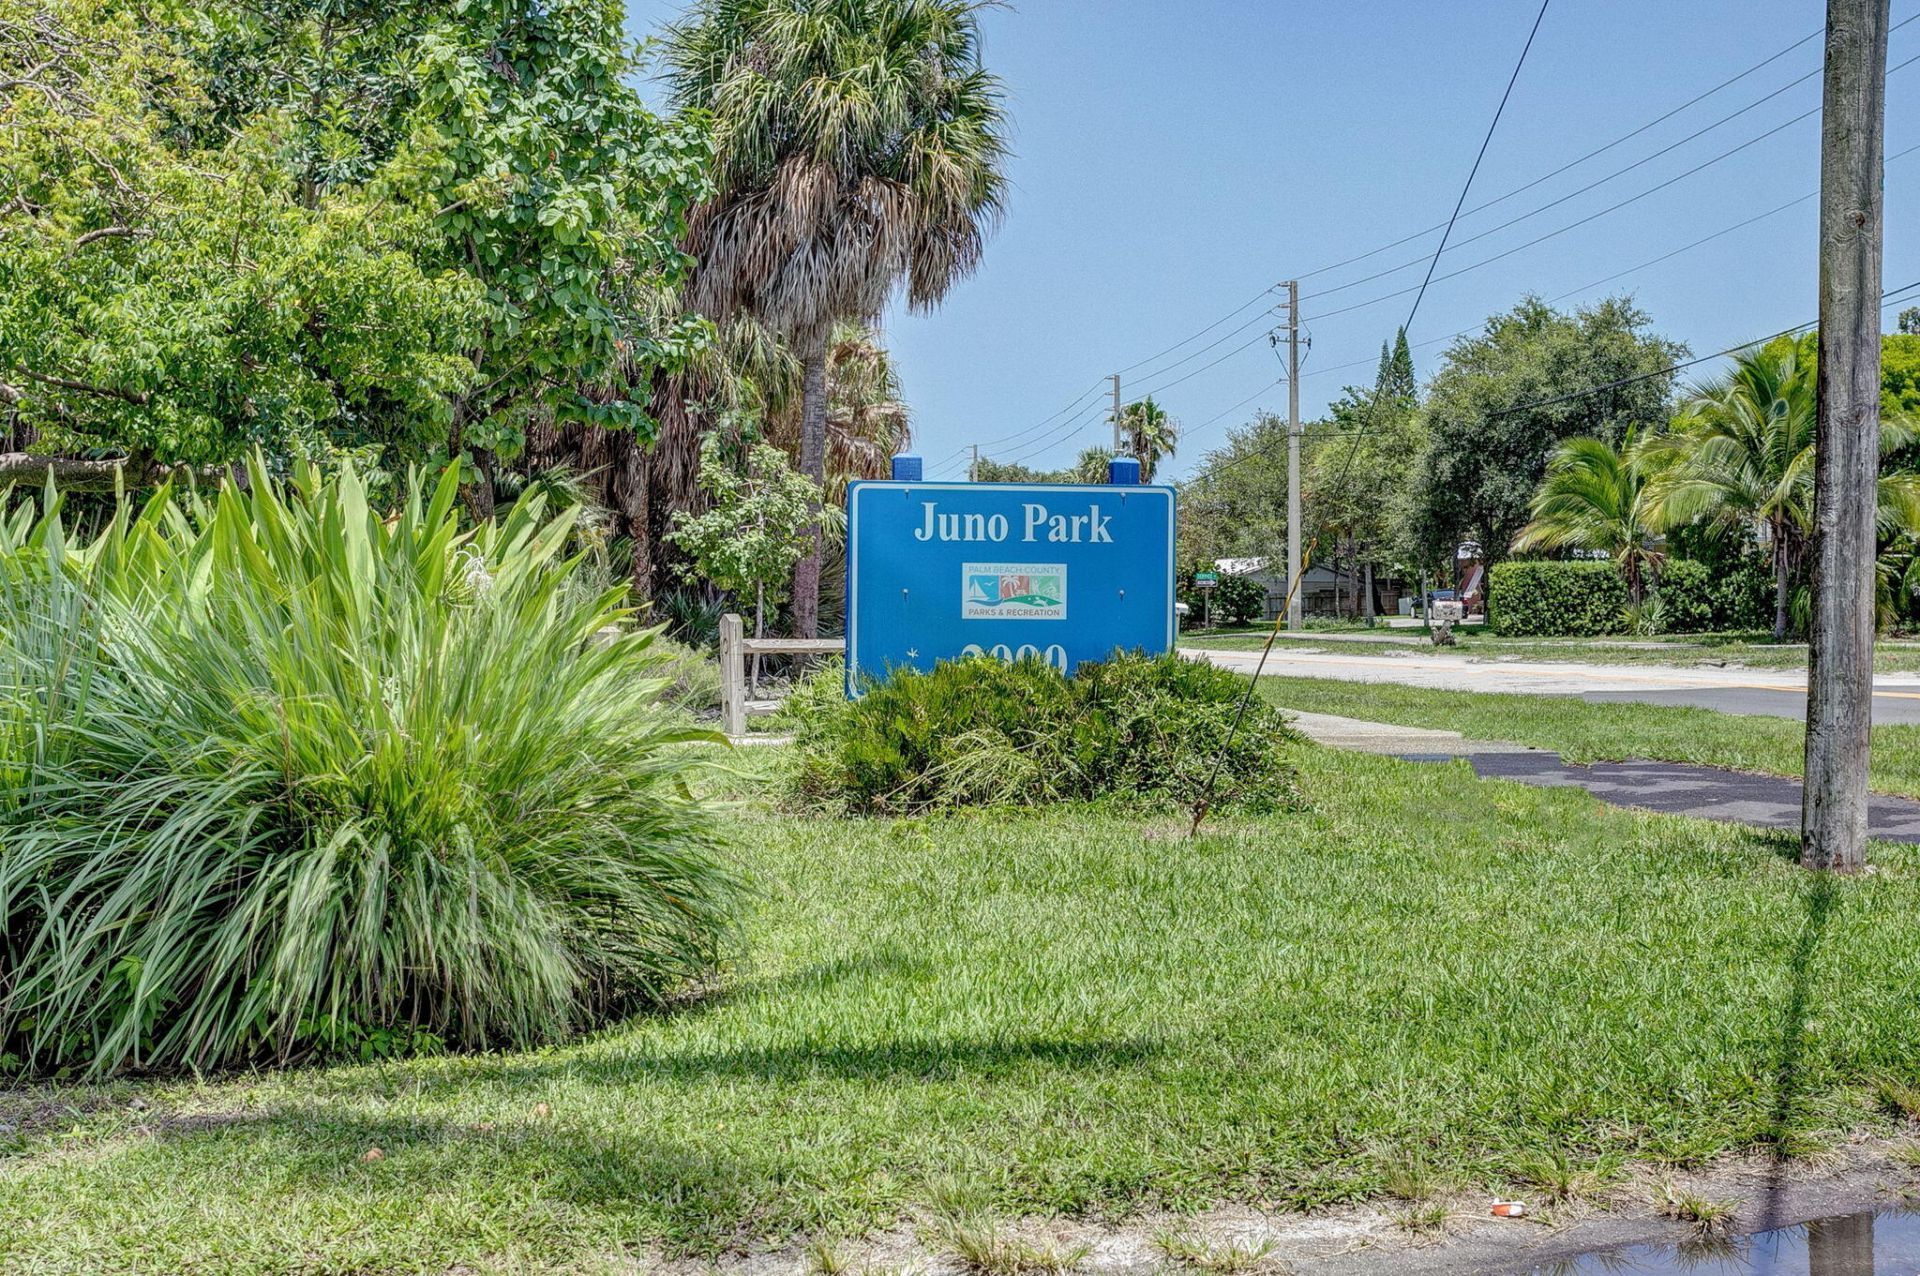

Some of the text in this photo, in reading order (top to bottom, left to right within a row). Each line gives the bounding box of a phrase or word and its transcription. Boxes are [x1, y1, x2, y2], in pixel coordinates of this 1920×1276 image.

[914, 502, 1114, 543] Juno Park
[968, 565, 1060, 574] PALM BEACH COUNTY
[968, 608, 1060, 616] PARKS & RECREATION
